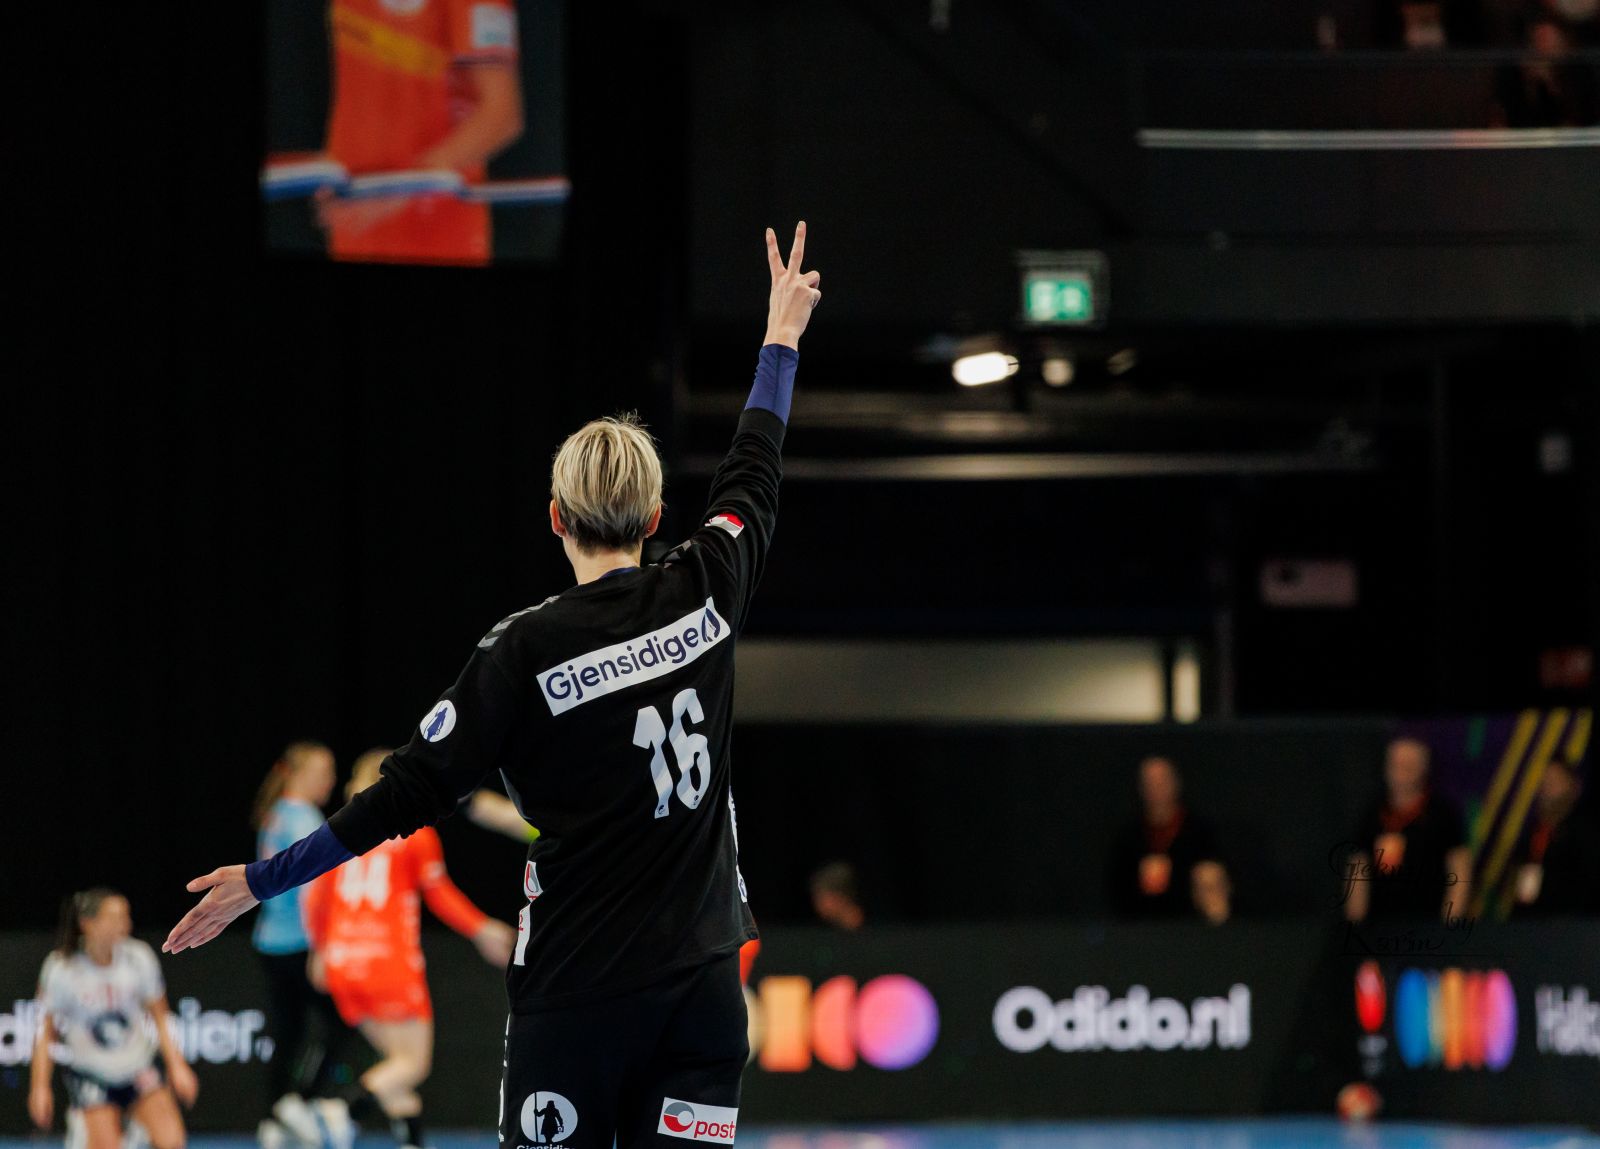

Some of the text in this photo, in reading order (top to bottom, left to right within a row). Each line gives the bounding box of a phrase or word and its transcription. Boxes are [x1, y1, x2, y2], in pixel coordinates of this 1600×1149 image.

[546, 627, 699, 701] Gjensidige
[633, 687, 711, 819] 16
[993, 983, 1251, 1052] Odido.nl
[693, 1119, 736, 1139] post
